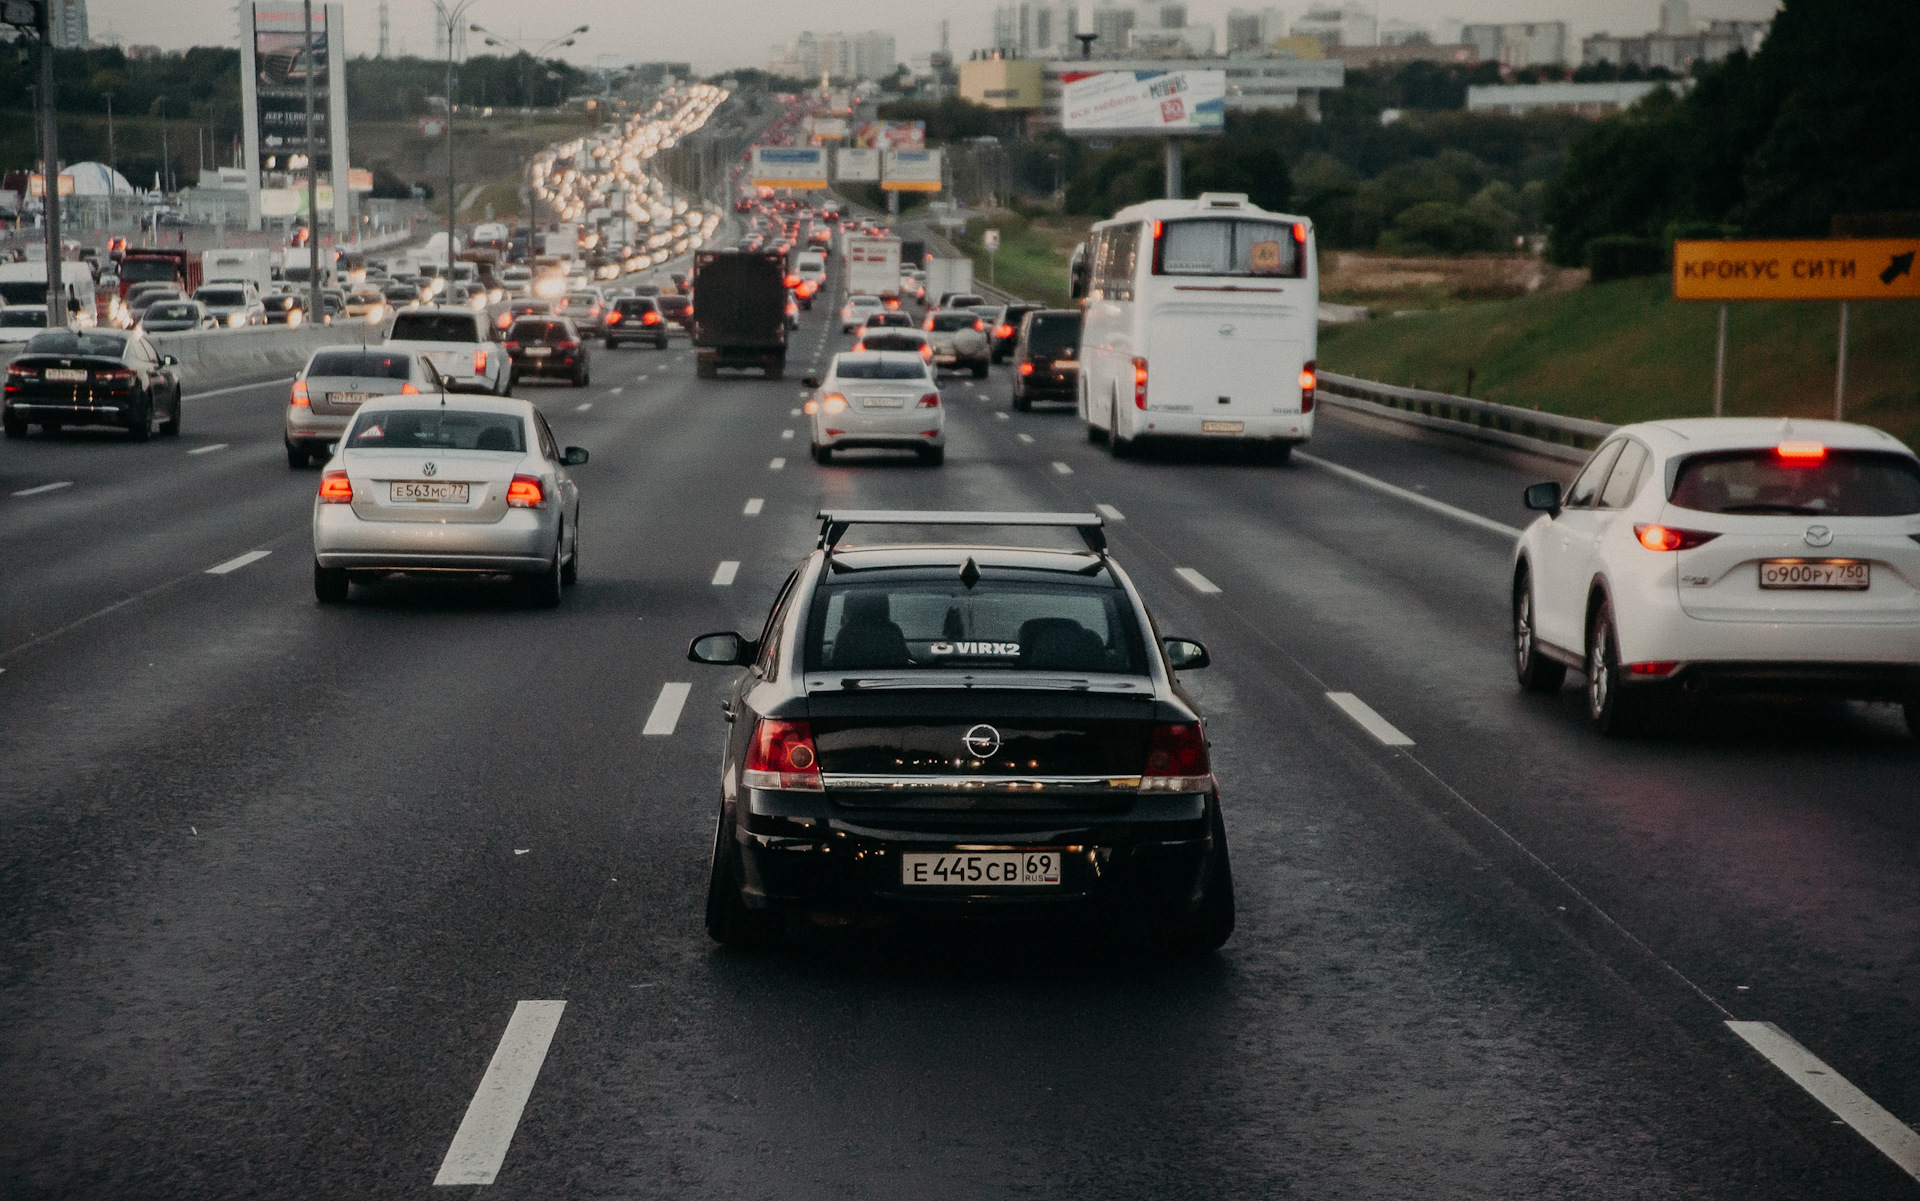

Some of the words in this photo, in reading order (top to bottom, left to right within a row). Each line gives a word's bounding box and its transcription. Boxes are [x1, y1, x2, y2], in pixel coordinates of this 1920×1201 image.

[1684, 259, 1779, 279] КРОКУС
[1793, 259, 1856, 279] СИТИ
[1839, 566, 1863, 579] 750
[956, 642, 1020, 656] VIRX2
[913, 857, 1018, 882] Е445СВ
[1026, 855, 1052, 875] 69
[1025, 874, 1044, 882] RUS
